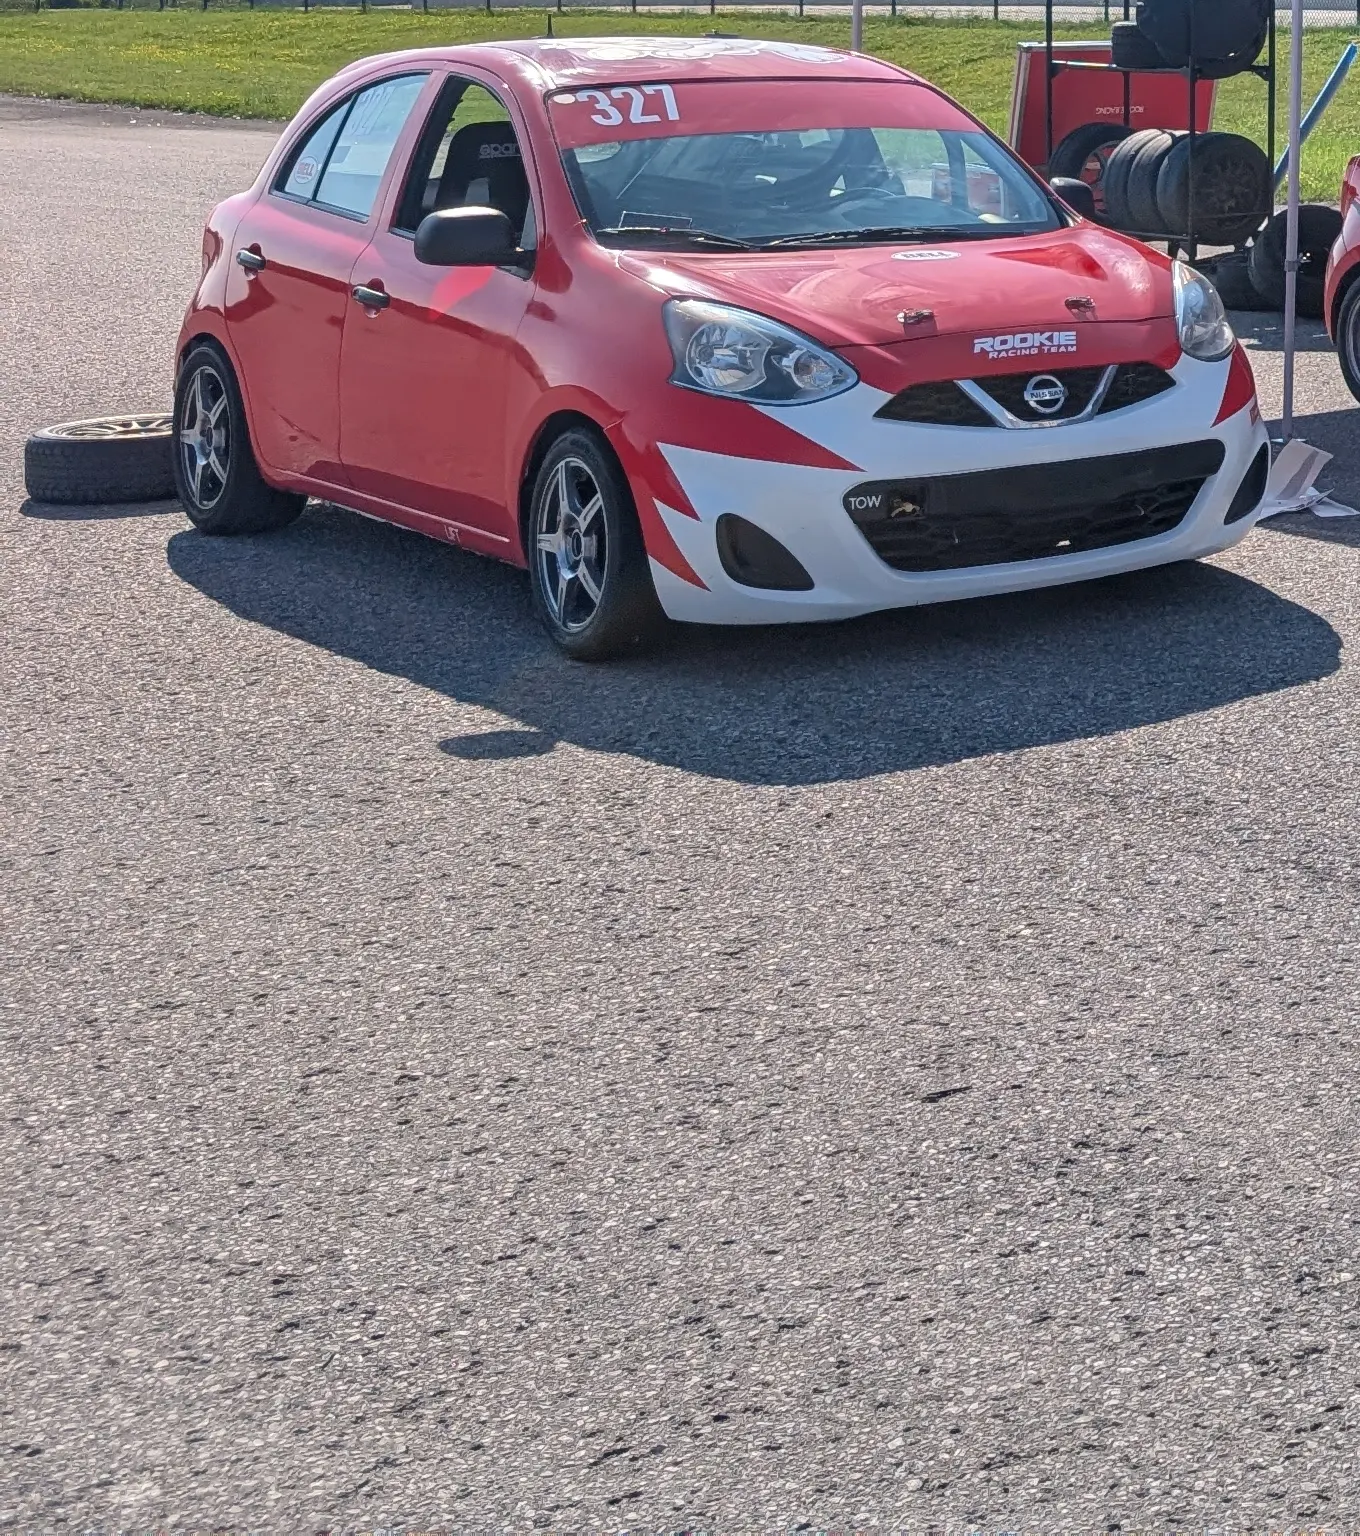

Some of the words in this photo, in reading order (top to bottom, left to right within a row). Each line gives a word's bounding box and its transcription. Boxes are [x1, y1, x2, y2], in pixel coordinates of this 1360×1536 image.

[576, 83, 680, 126] 327
[973, 331, 1077, 354] ROOKIE
[988, 347, 1038, 360] RACING
[1042, 345, 1077, 354] TEAM
[1030, 389, 1064, 400] NISSAN
[848, 494, 882, 511] TOW
